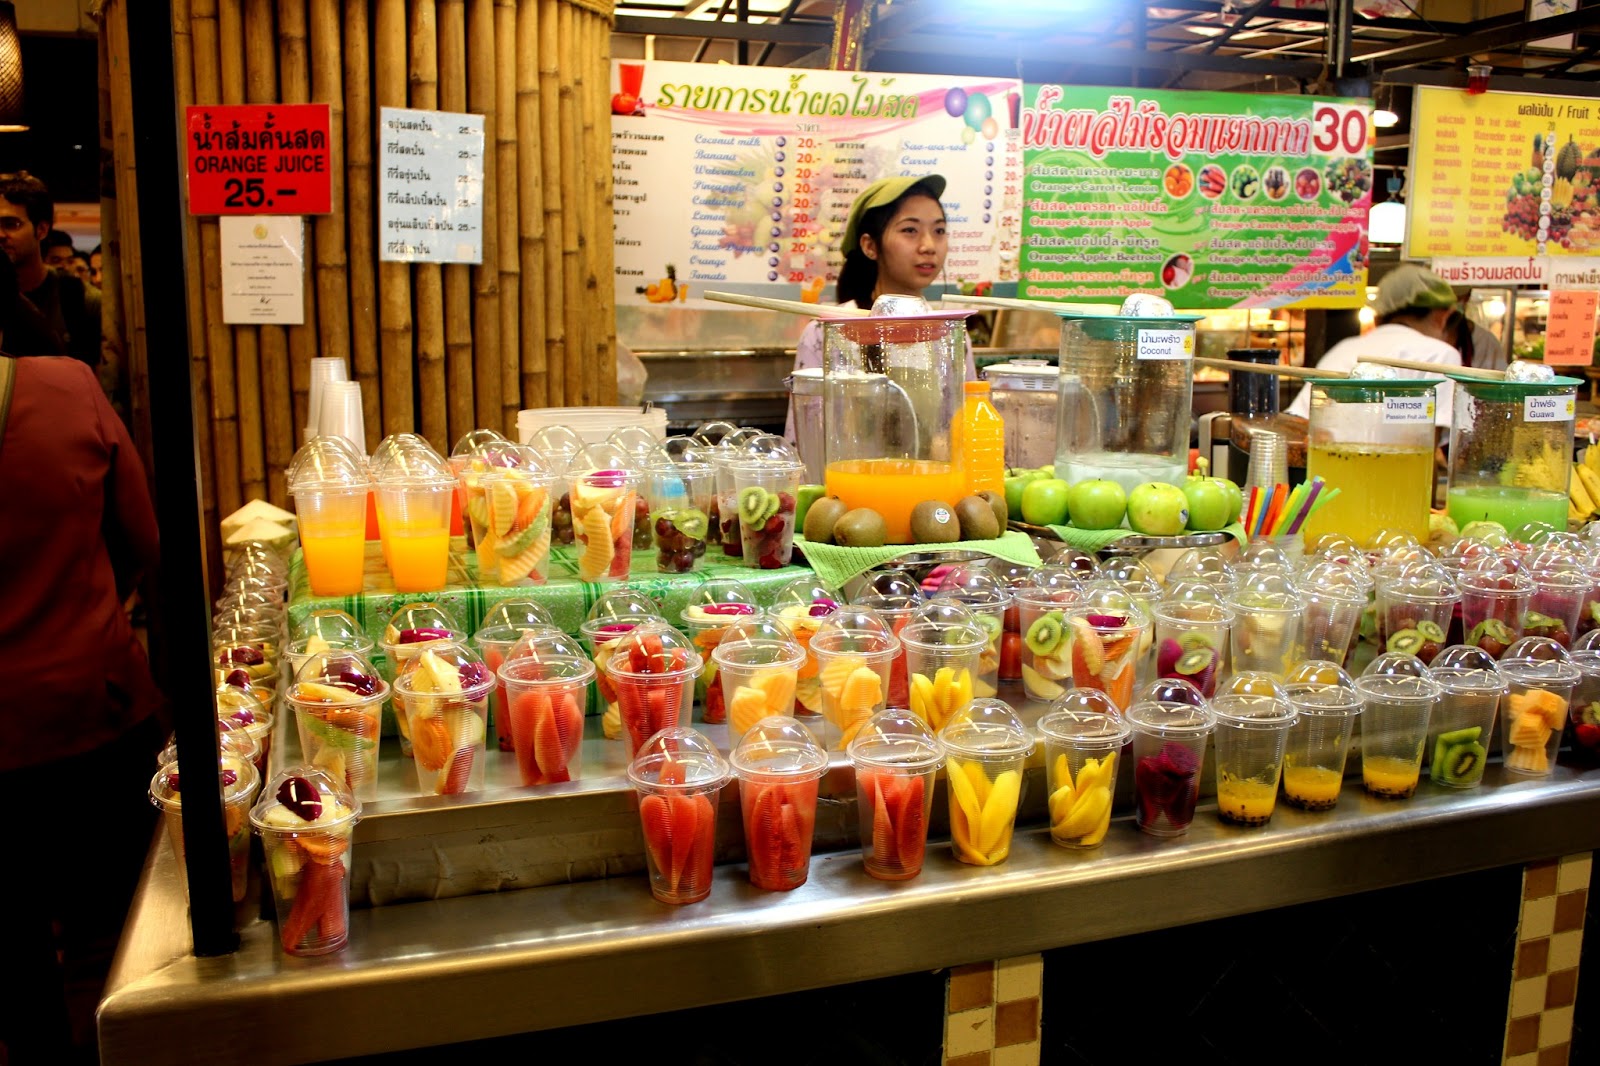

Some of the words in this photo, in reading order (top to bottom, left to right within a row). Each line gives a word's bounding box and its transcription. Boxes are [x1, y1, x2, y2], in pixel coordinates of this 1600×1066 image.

[657, 73, 920, 118] รายการน้ำผลไม้สด
[1567, 106, 1589, 119] Fruit
[193, 112, 325, 150] น้ำส้มคั้นสด
[1314, 107, 1367, 154] 30
[694, 133, 735, 145] Coconut
[737, 136, 761, 146] milk
[797, 137, 822, 148] 20.-
[458, 151, 477, 159] 25.-
[694, 149, 737, 161] Banana
[796, 153, 821, 163] 20.-
[901, 156, 938, 165] Carrot
[195, 155, 267, 173] ORANGE
[274, 155, 324, 172] JUICE
[693, 165, 755, 177] Watermelon
[795, 168, 820, 179] 20.-
[224, 178, 297, 207] 25.-
[692, 180, 746, 194] Pineapple
[794, 183, 819, 194] 20.-
[793, 198, 818, 209] 20.-
[692, 211, 726, 221] Lemon
[792, 213, 816, 224] 20.-
[691, 226, 726, 237] Guava
[792, 228, 816, 238] 20.-
[791, 242, 815, 253] 20.-
[689, 255, 726, 268] Orange
[689, 270, 727, 280] Tomato
[789, 271, 813, 283] 20.-
[1141, 332, 1181, 343] น้ำมะพร้าว
[1141, 346, 1172, 354] Coconut
[1387, 399, 1422, 409] น้ำเสาวรส
